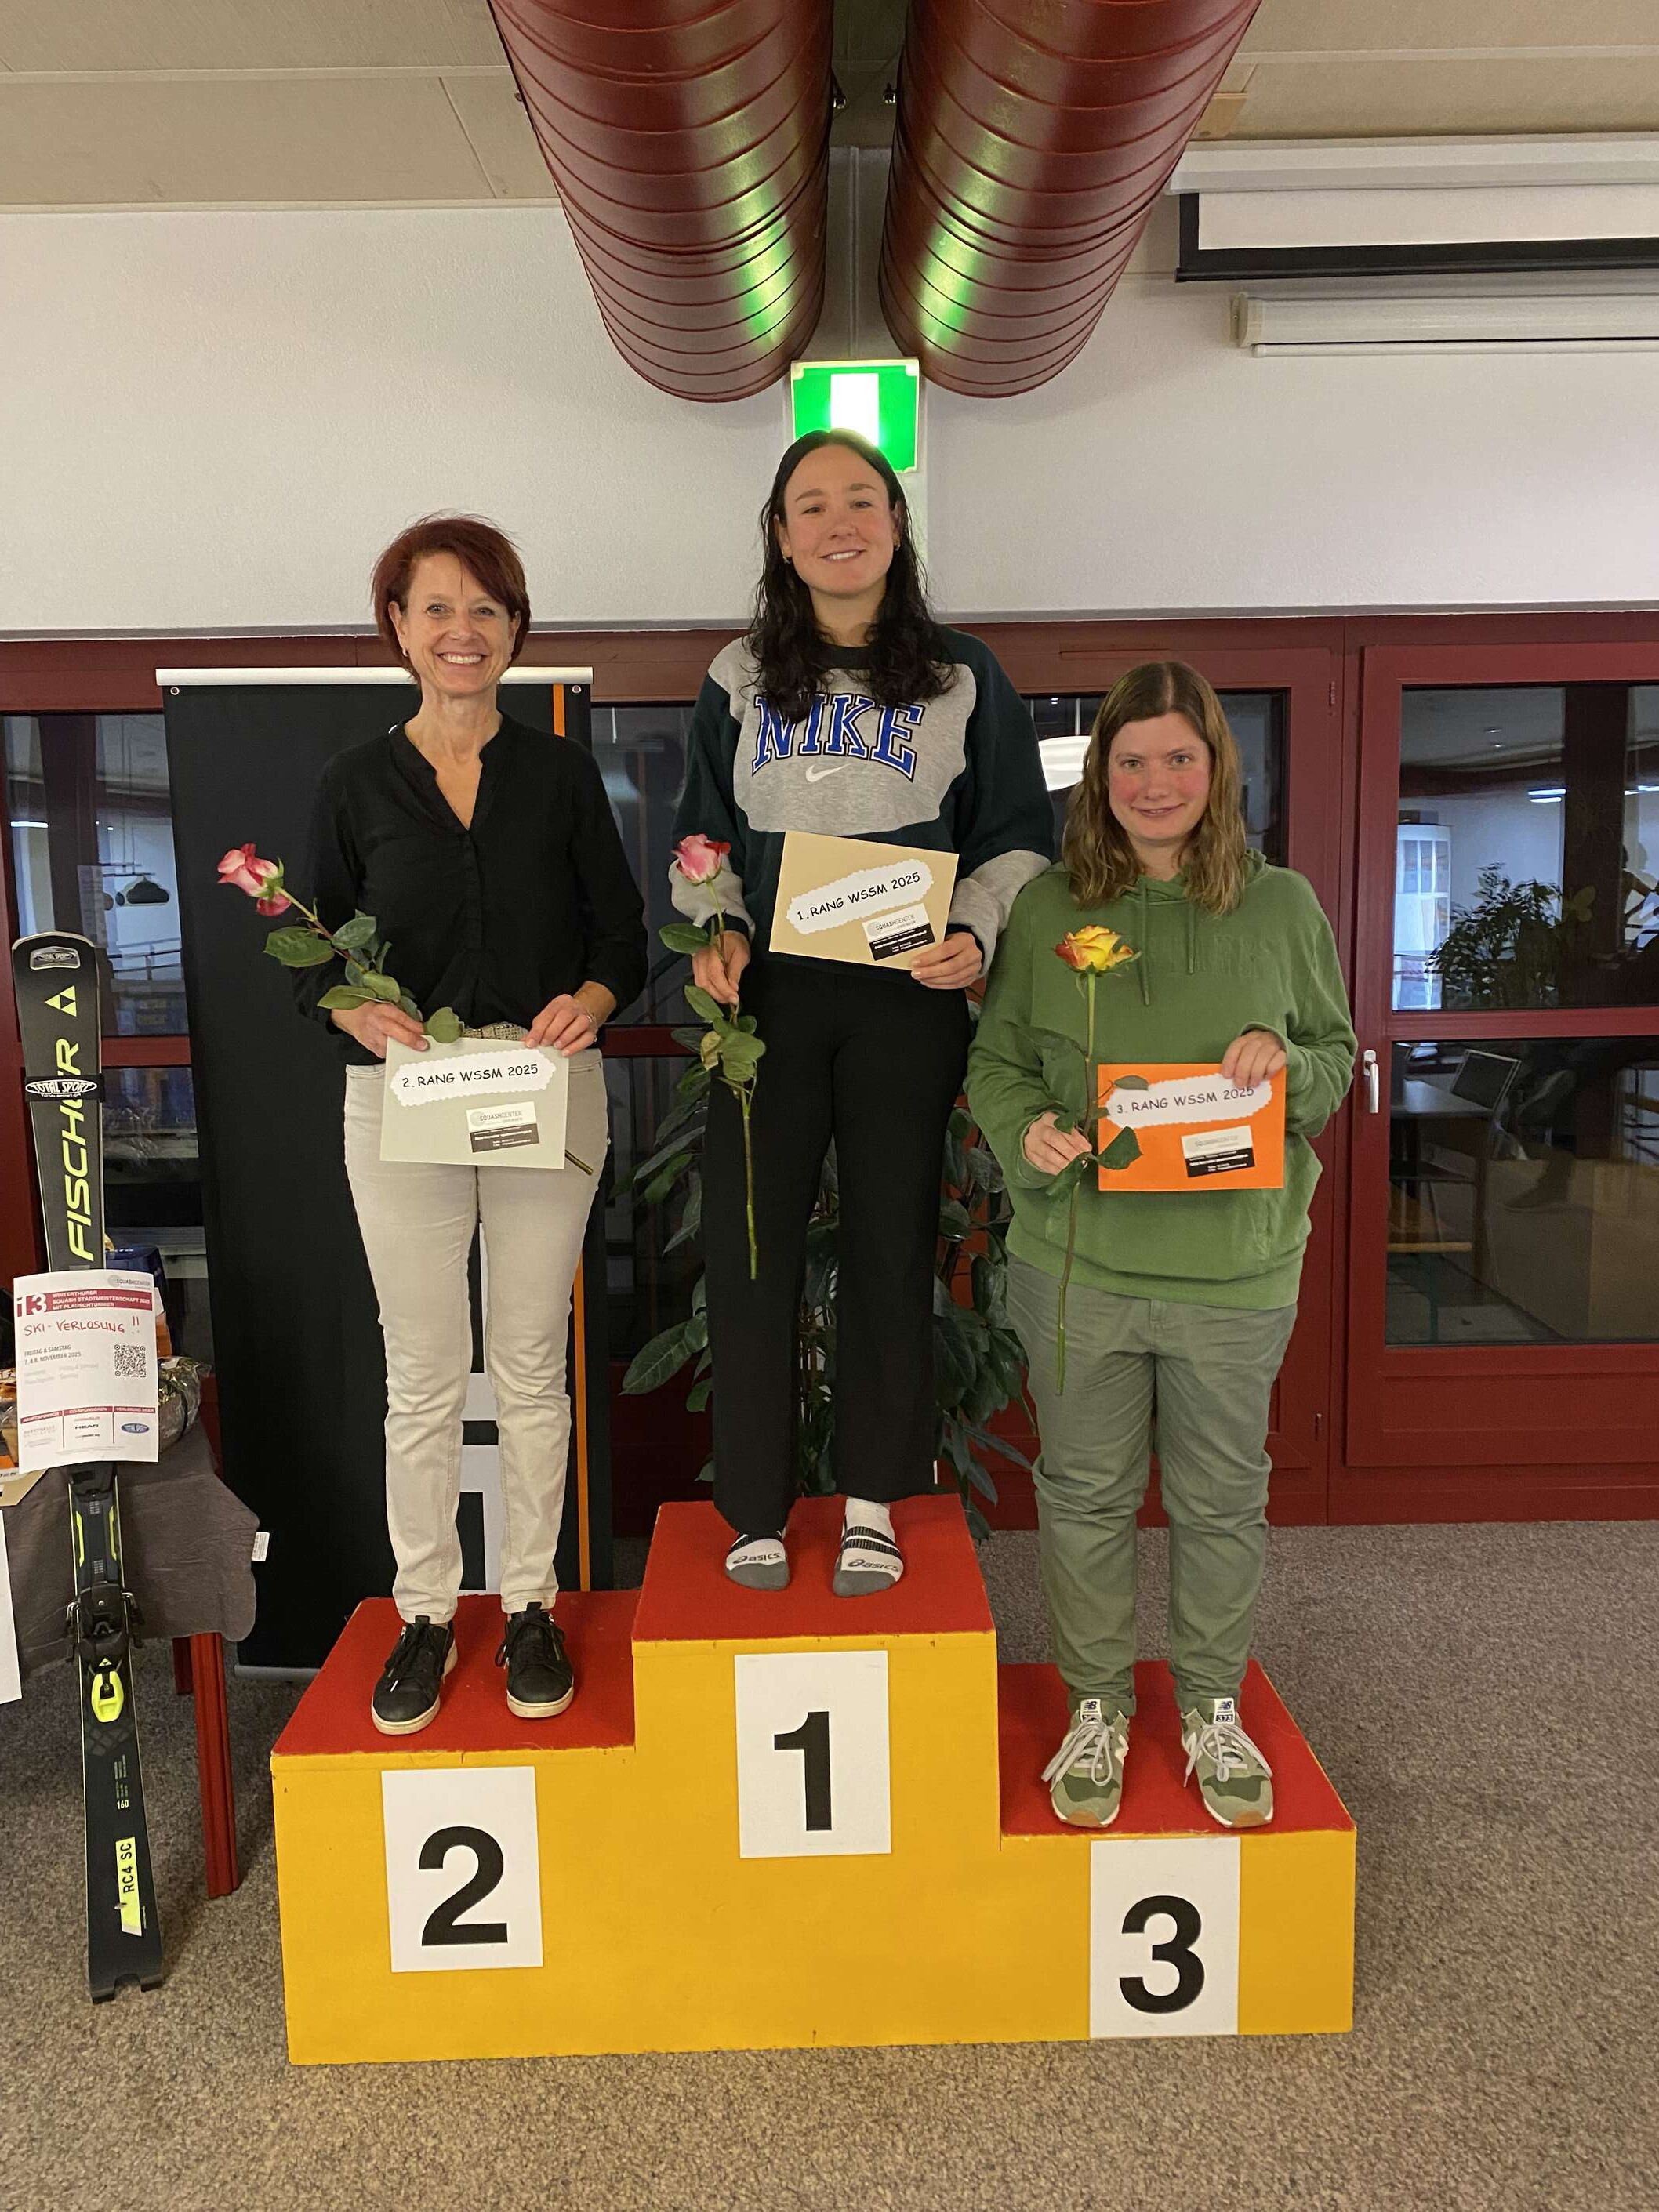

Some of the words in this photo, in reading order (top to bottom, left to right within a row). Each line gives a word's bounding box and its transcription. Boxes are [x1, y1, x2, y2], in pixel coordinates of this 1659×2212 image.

[751, 694, 926, 782] NIKE
[797, 911, 810, 921] 1.
[811, 897, 844, 916] RANG
[848, 884, 888, 904] WSSM
[891, 872, 920, 890] 2025
[31, 1081, 60, 1093] TOTAL
[61, 1081, 93, 1092] SPORT
[402, 1077, 415, 1088] 2.
[418, 1073, 455, 1086] RANG
[460, 1068, 502, 1082] WSSM
[508, 1064, 538, 1076] 2025
[1116, 1104, 1127, 1114] 3.
[1131, 1098, 1168, 1111] RANG
[1174, 1092, 1218, 1106] WSSM
[1223, 1087, 1254, 1100] 2025
[480, 1110, 522, 1122] SQUASHCENTER
[56, 1038, 94, 1261] FISCHR
[56, 1320, 125, 1333] VERLOSUNG
[39, 1354, 68, 1362] NOVEMBER
[48, 1344, 71, 1353] SAMSTAG
[775, 1712, 831, 1831] 1
[117, 1800, 129, 1810] 160
[120, 1842, 132, 1859] SC
[122, 1865, 135, 1894] RC4
[419, 1826, 507, 1945] 2
[1120, 1896, 1204, 2013] 3
